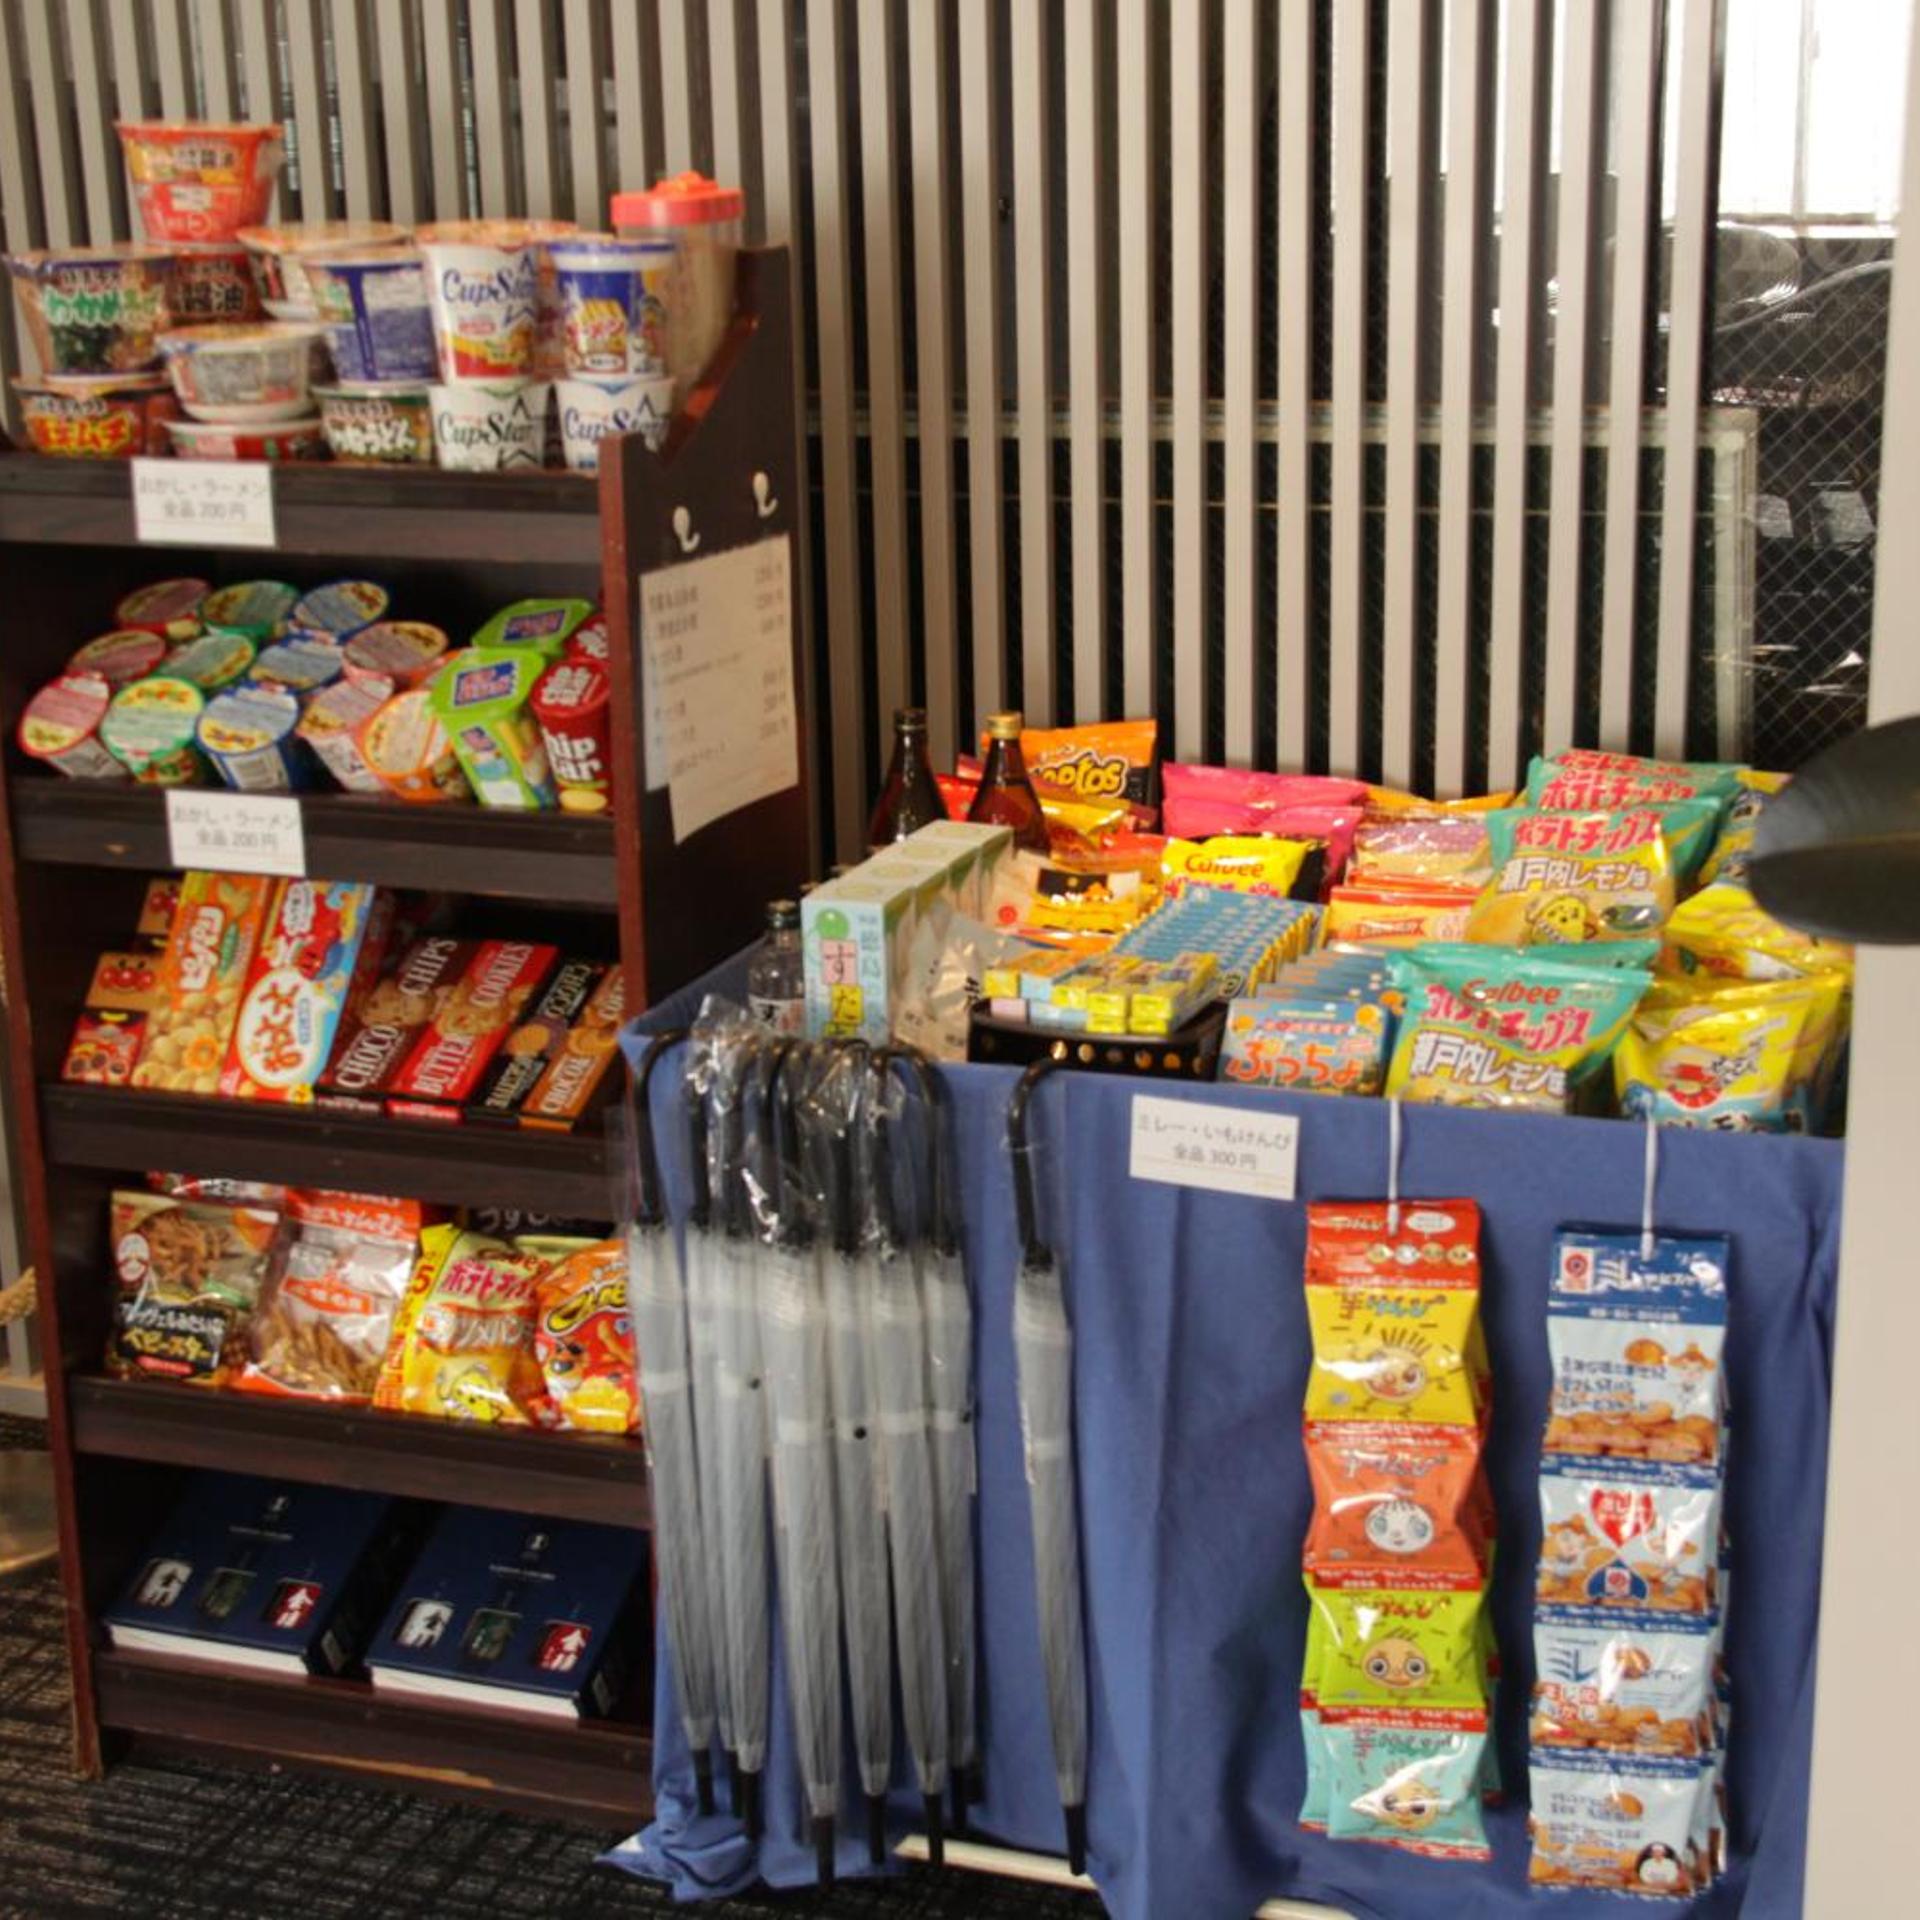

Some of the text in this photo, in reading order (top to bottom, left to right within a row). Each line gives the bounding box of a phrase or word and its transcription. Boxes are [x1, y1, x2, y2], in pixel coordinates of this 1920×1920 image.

[336, 935, 457, 1089] CHOCO CHIPS
[1461, 978, 1561, 1006] Calbee
